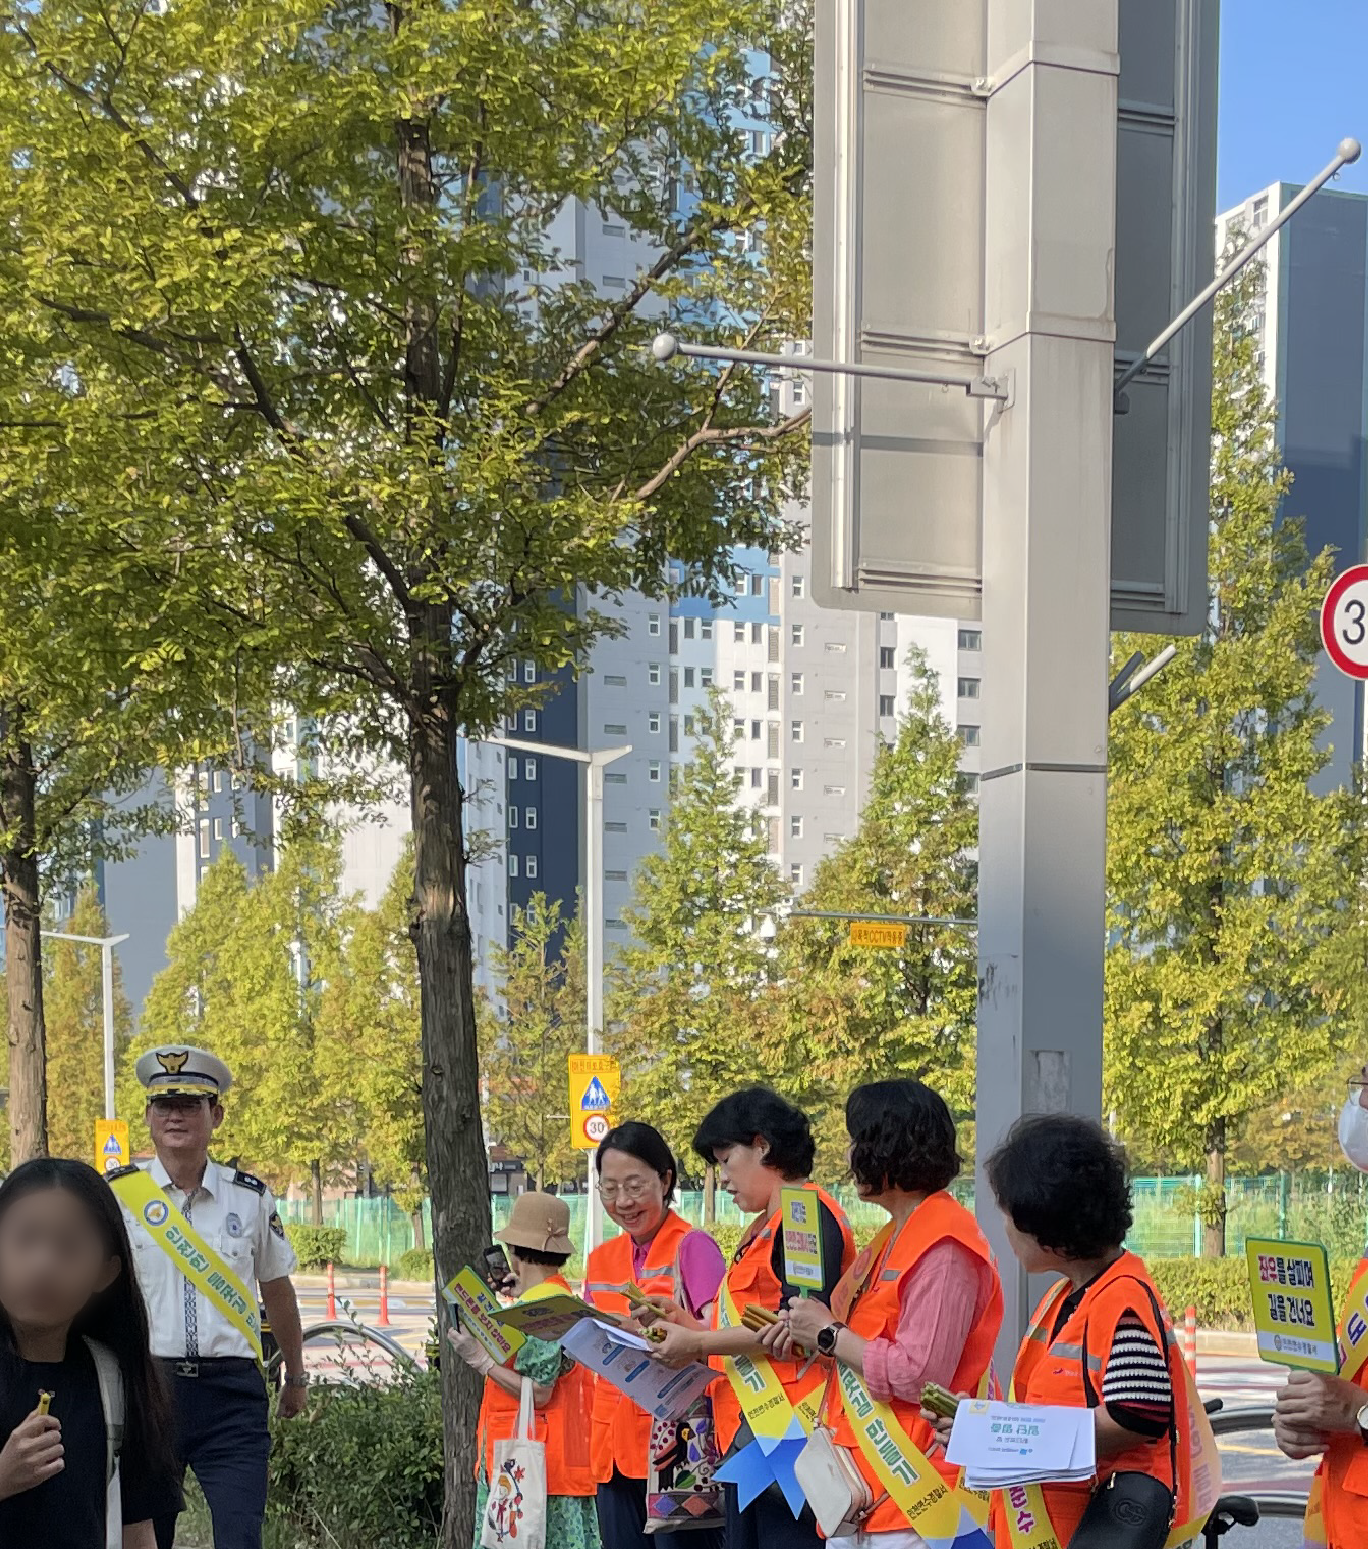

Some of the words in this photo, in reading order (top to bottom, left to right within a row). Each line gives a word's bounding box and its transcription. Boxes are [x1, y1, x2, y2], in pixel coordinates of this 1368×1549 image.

[589, 1121, 606, 1135] 30
[164, 1225, 211, 1274] 안전한
[1346, 1311, 1368, 1347] 내
[864, 1417, 919, 1486] 만들기
